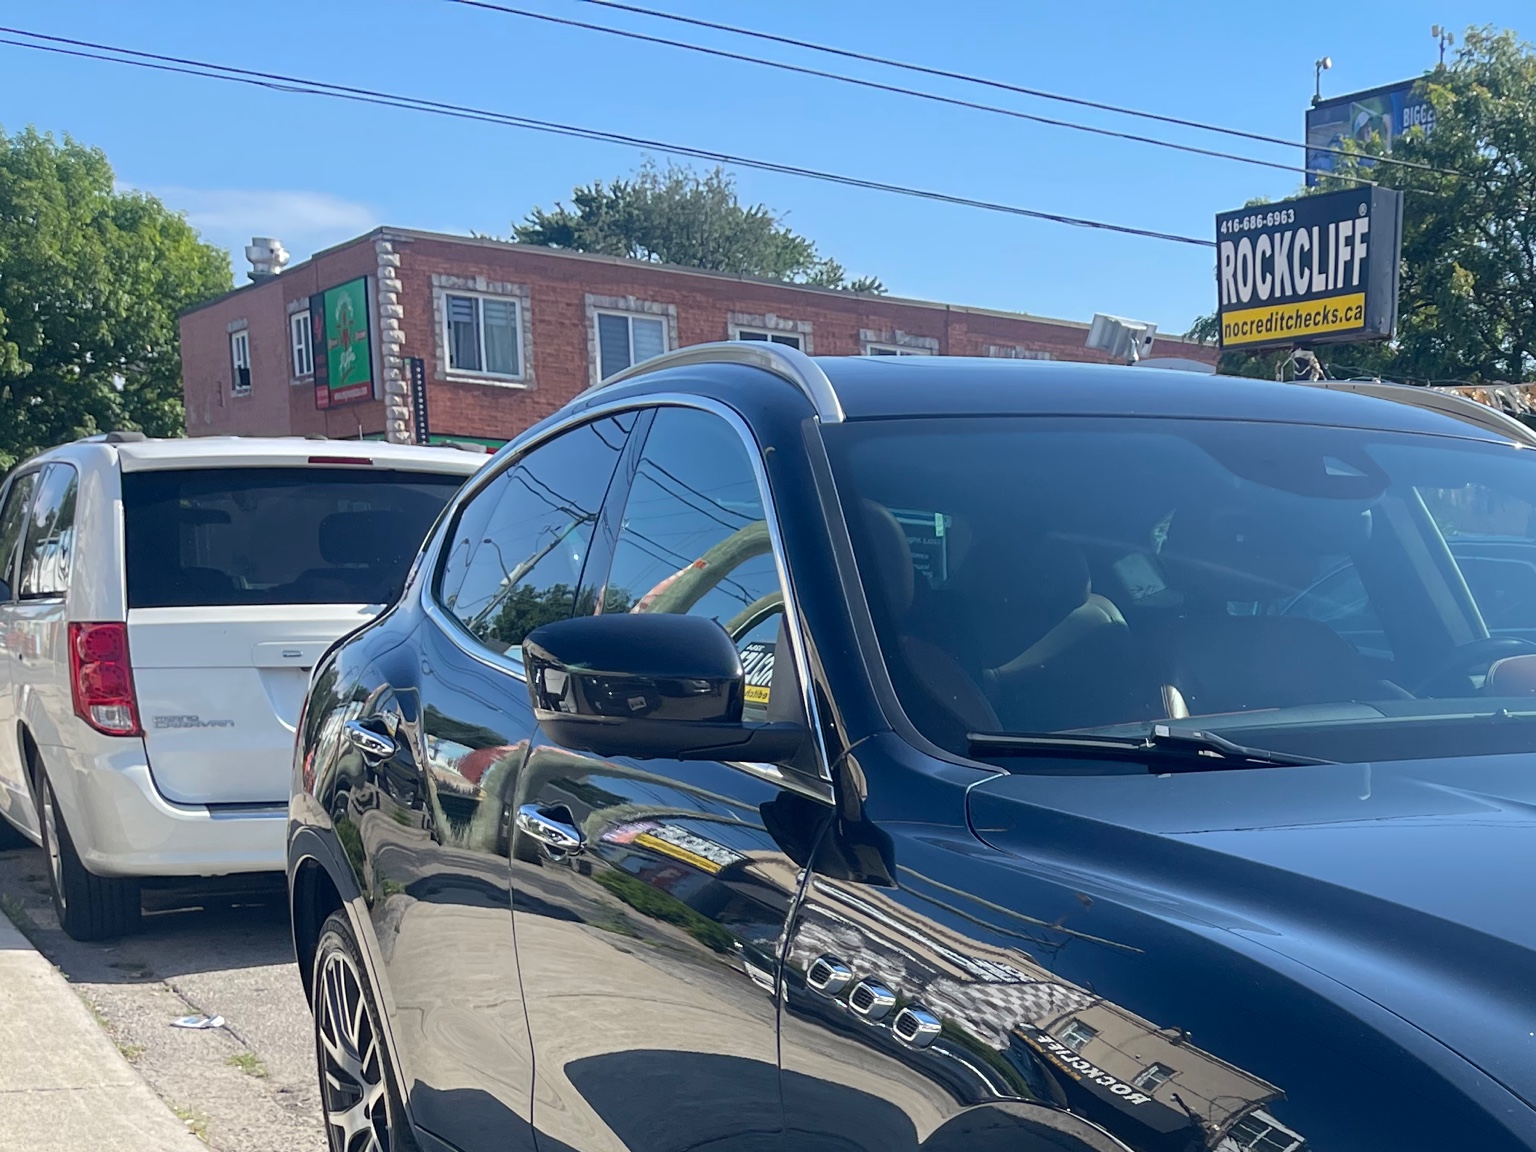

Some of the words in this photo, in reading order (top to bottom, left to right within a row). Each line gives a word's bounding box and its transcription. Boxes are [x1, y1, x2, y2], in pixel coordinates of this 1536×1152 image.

[1220, 209, 1295, 234] 416-686-6963
[1220, 217, 1369, 305] ROCKCLIFF
[1223, 303, 1364, 338] nocreditchecks.ca
